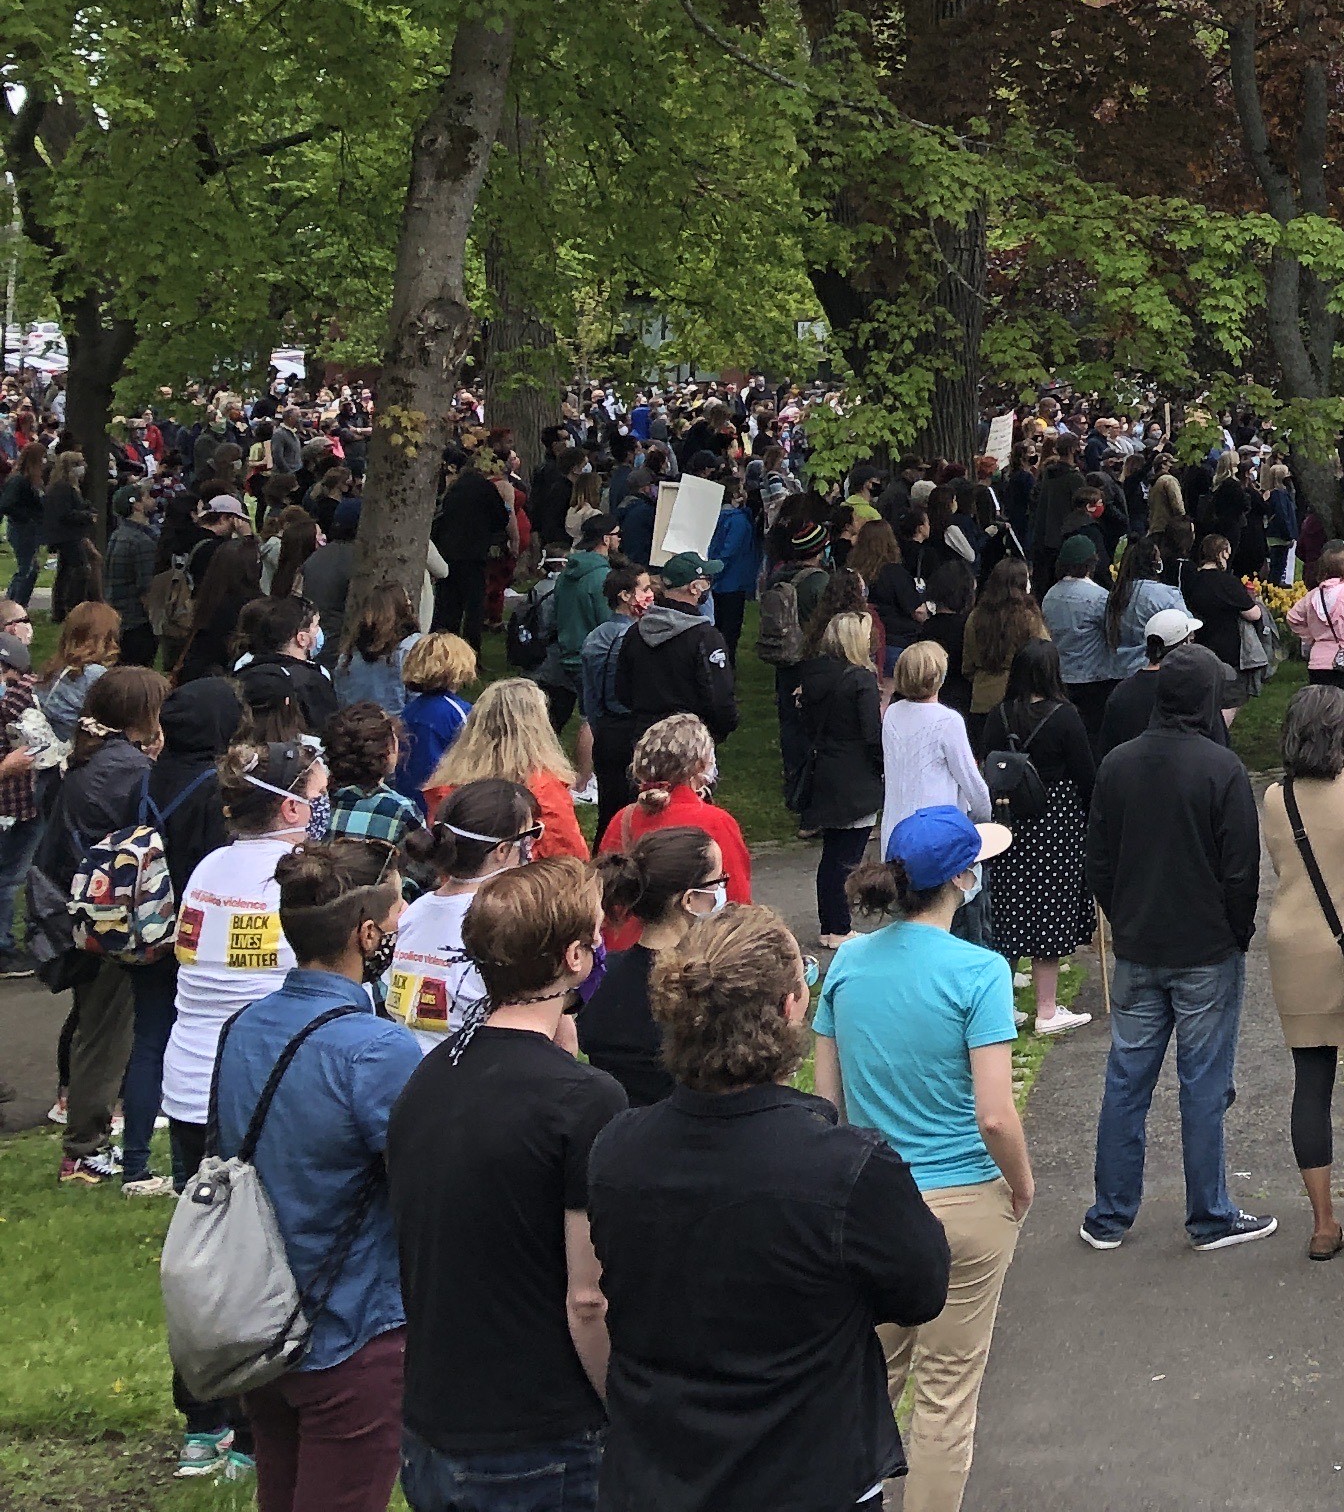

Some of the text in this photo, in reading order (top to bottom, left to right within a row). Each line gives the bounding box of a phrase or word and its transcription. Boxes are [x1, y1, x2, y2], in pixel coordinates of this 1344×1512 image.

[223, 897, 267, 910] violence
[232, 916, 270, 929] BLACK
[232, 934, 261, 949] LIVES
[228, 953, 278, 967] MATTER
